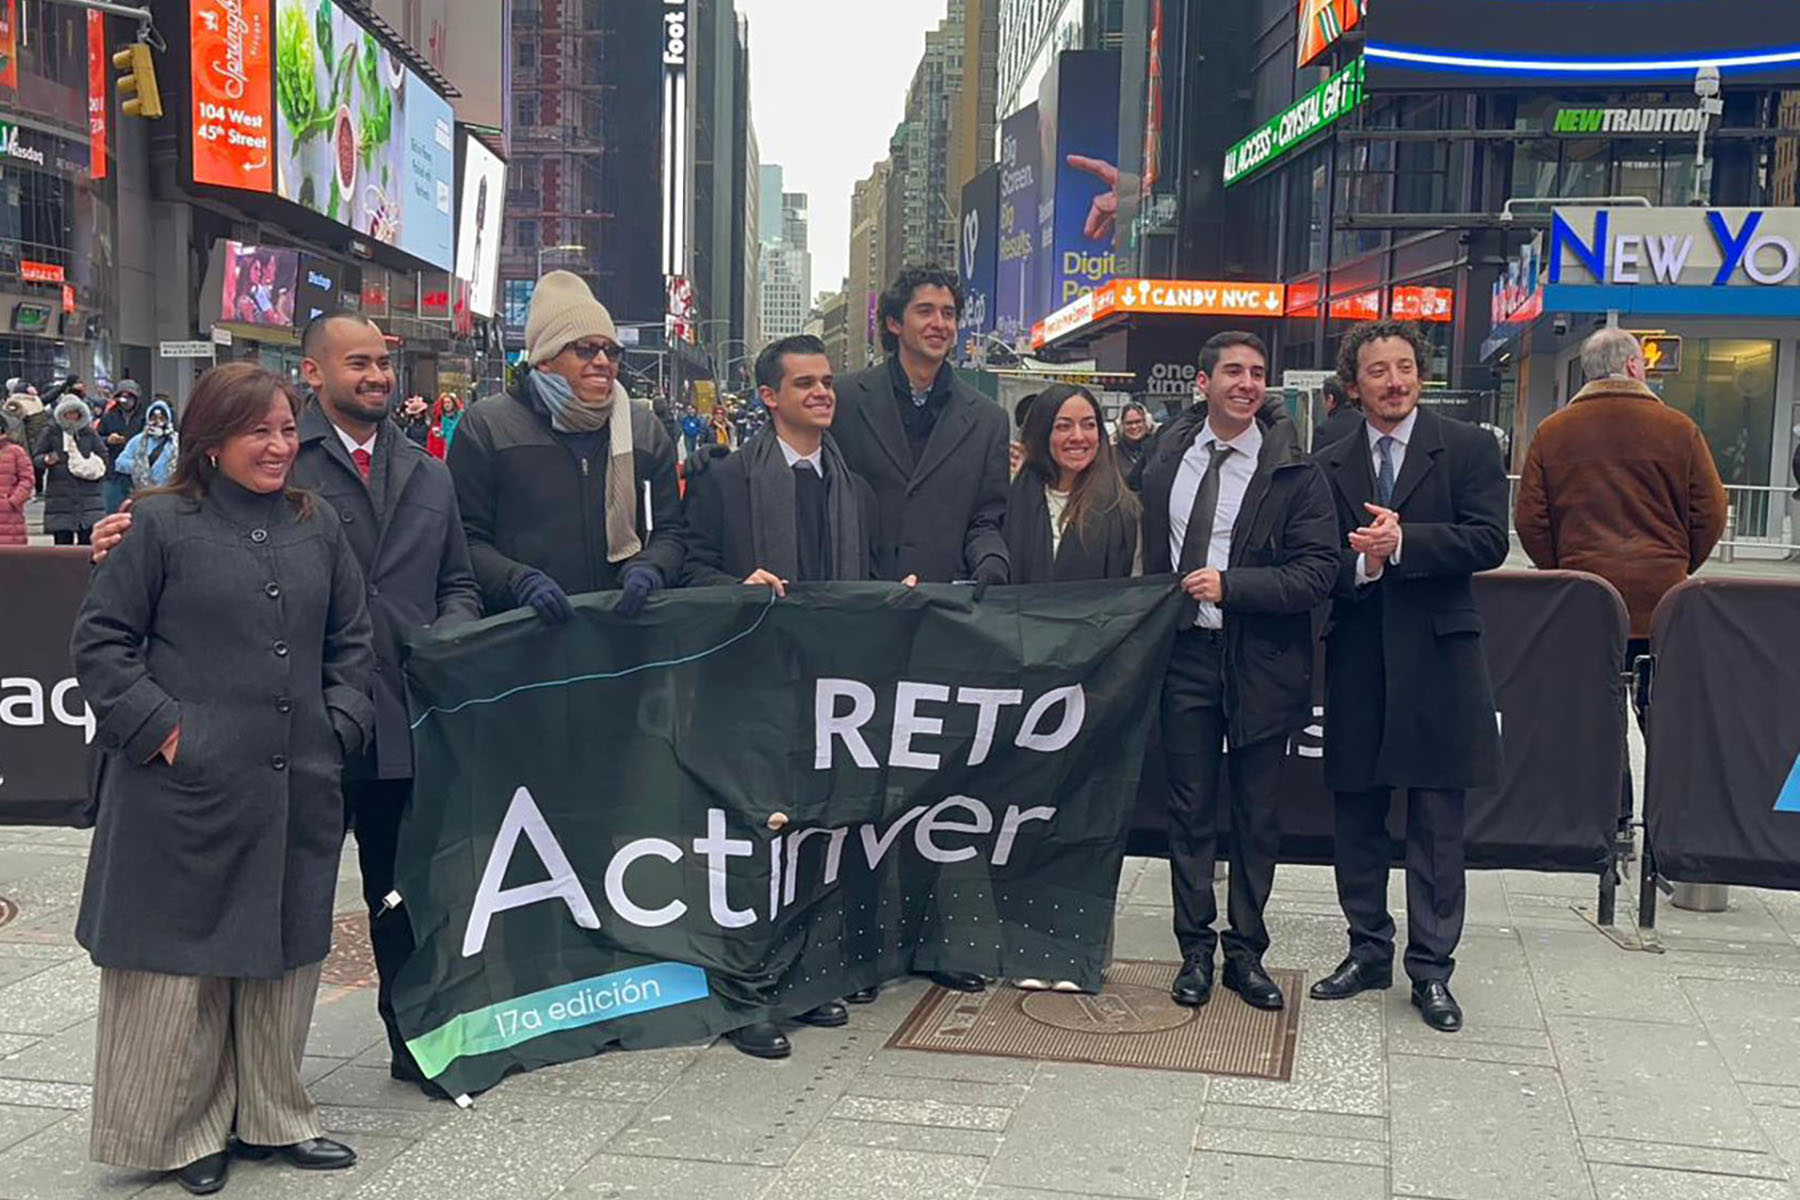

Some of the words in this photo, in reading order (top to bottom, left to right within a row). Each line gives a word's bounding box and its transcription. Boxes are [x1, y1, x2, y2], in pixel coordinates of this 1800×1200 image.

[663, 11, 685, 64] Foot
[199, 101, 226, 120] 104
[227, 108, 263, 127] West
[227, 128, 267, 149] Street
[1279, 92, 1321, 147] CRYSTAL
[1550, 209, 1693, 285] NEW
[1152, 287, 1218, 307] CANDY
[1221, 290, 1261, 308] NYC
[1152, 364, 1196, 382] one
[813, 677, 1086, 770] RETO
[462, 785, 1057, 958] Actinver
[495, 1008, 542, 1038] 17a
[548, 977, 661, 1021] edición
